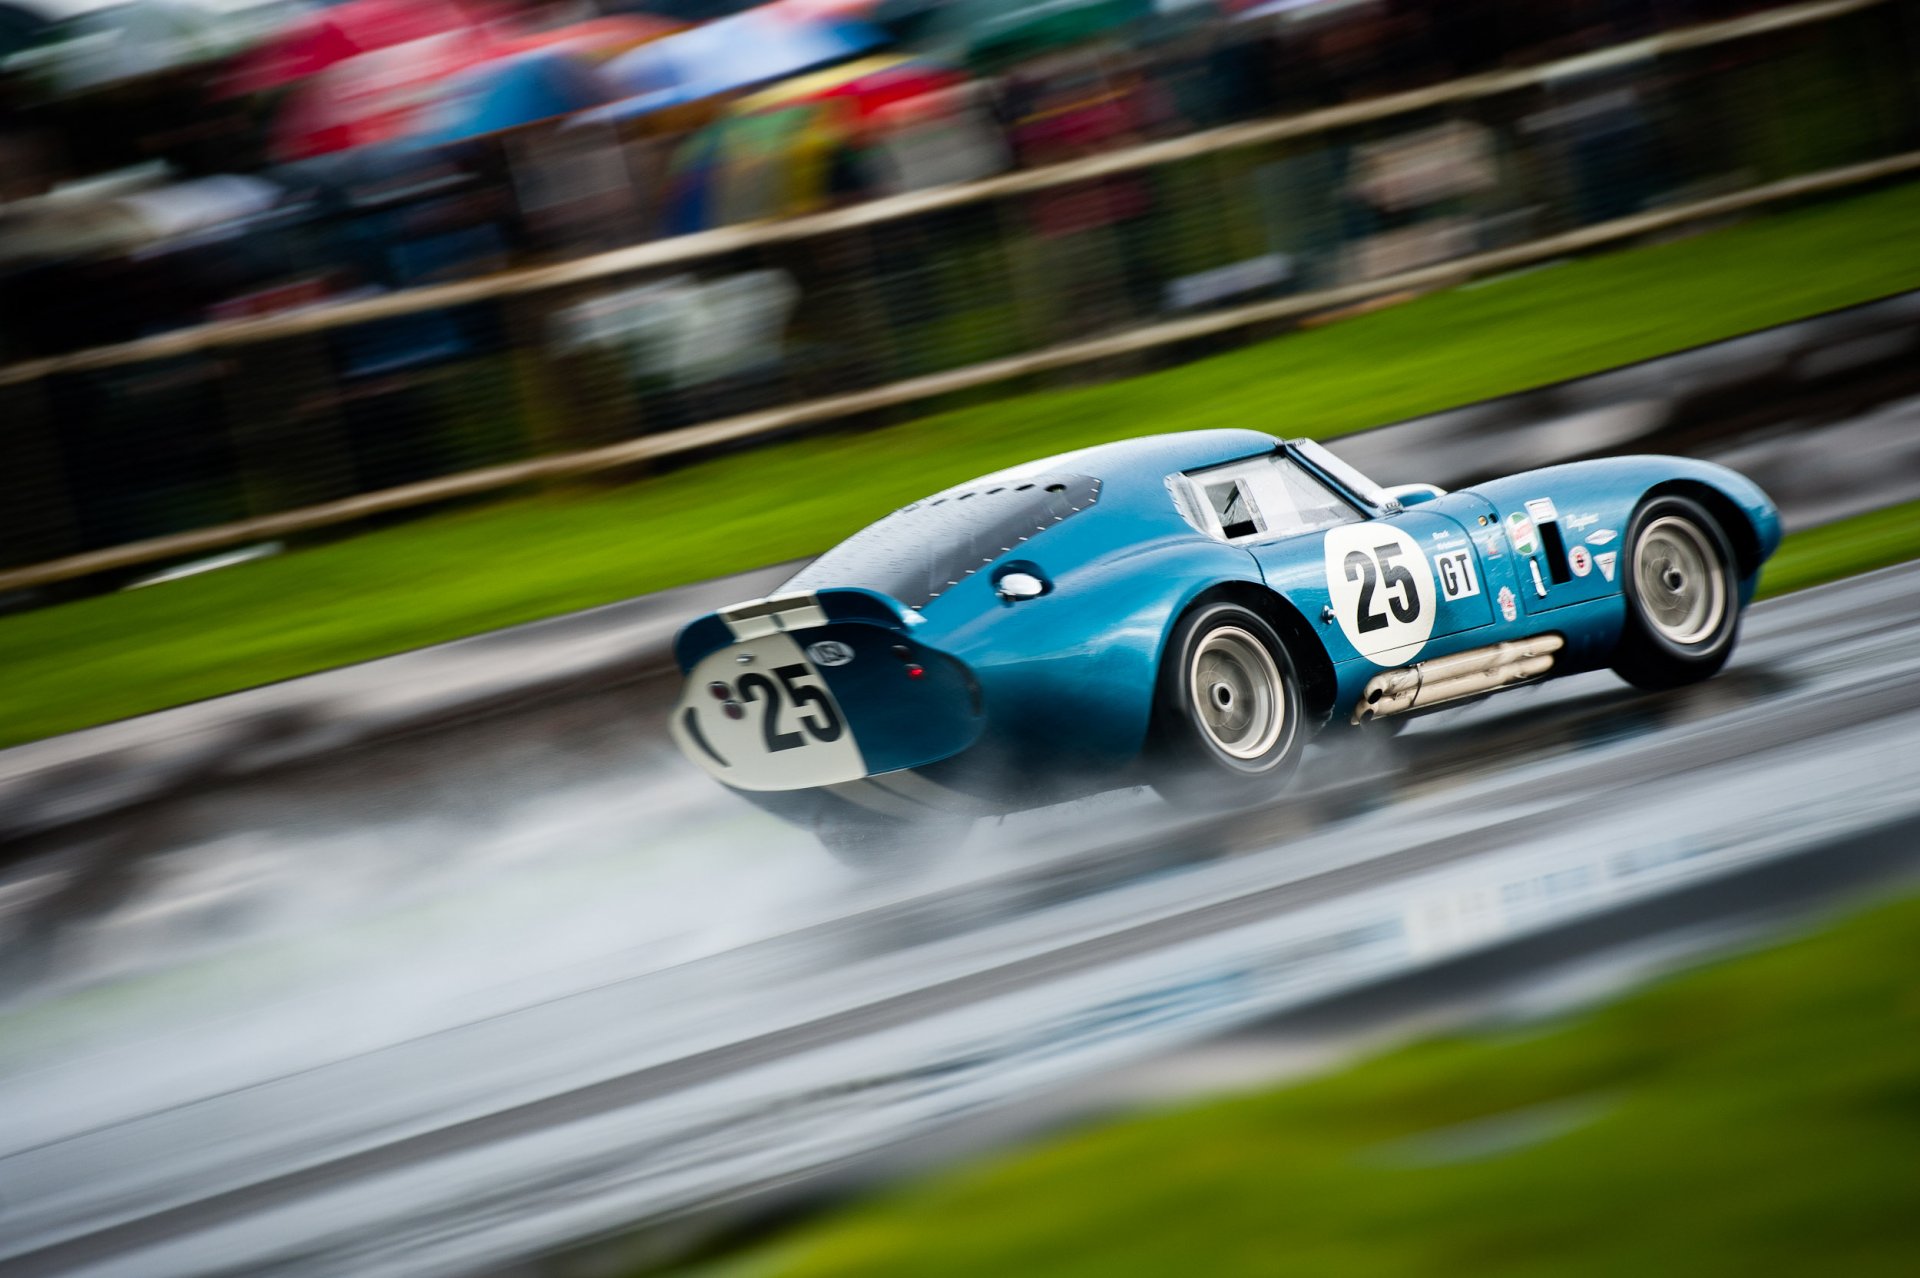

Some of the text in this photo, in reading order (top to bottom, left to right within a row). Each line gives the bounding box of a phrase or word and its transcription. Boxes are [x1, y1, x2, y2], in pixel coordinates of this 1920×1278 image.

[1344, 542, 1421, 634] 25
[1440, 553, 1472, 596] GT
[736, 662, 842, 753] 25
